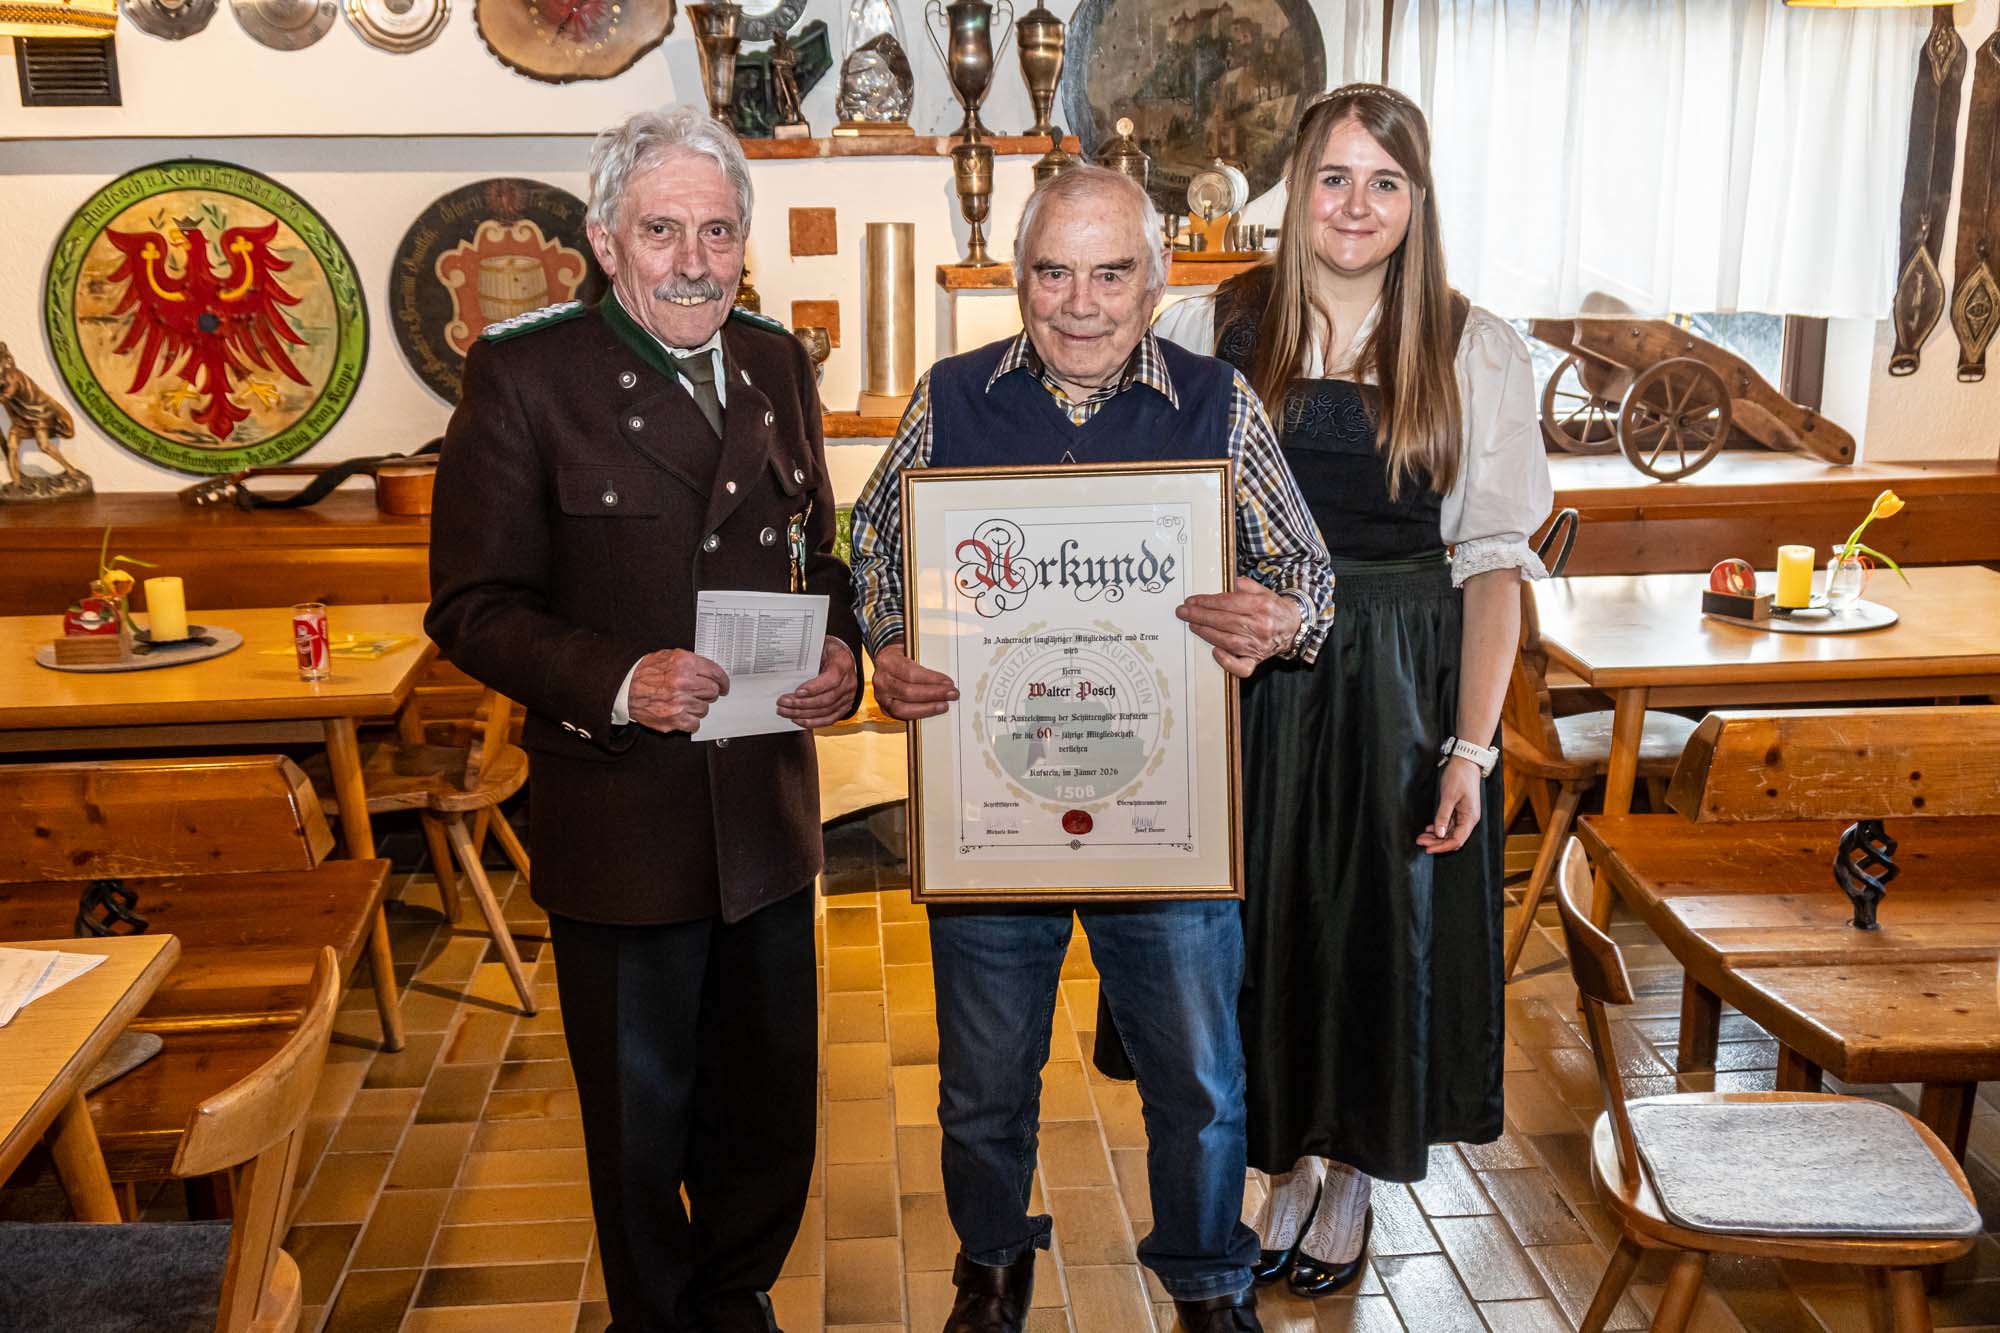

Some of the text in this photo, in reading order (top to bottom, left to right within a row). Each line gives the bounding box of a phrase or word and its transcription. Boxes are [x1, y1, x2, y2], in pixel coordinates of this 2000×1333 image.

[955, 527, 1176, 611] Urkunde
[993, 635, 1032, 645] Anbetracht
[1034, 635, 1072, 645] langjähriger
[1075, 633, 1122, 644] Mitgliedschaft
[1125, 633, 1137, 641] und
[1139, 633, 1159, 641] Treue
[1063, 647, 1079, 655] wird
[1062, 667, 1082, 677] Herrn
[1027, 681, 1116, 701] Walter Posch
[1010, 714, 1057, 724] Auszeichnung
[1058, 714, 1069, 722] der
[1071, 713, 1116, 723] Schützengilde
[1119, 713, 1149, 722] Kufstein
[1012, 732, 1023, 741] für
[1036, 726, 1052, 739] 60
[1061, 731, 1084, 740] jährige
[1086, 729, 1135, 740] Mitgliedschaft
[1058, 744, 1088, 754] verliehen
[1030, 767, 1119, 778] Kufstein, im Jänner 2026
[1055, 784, 1096, 799] 1508
